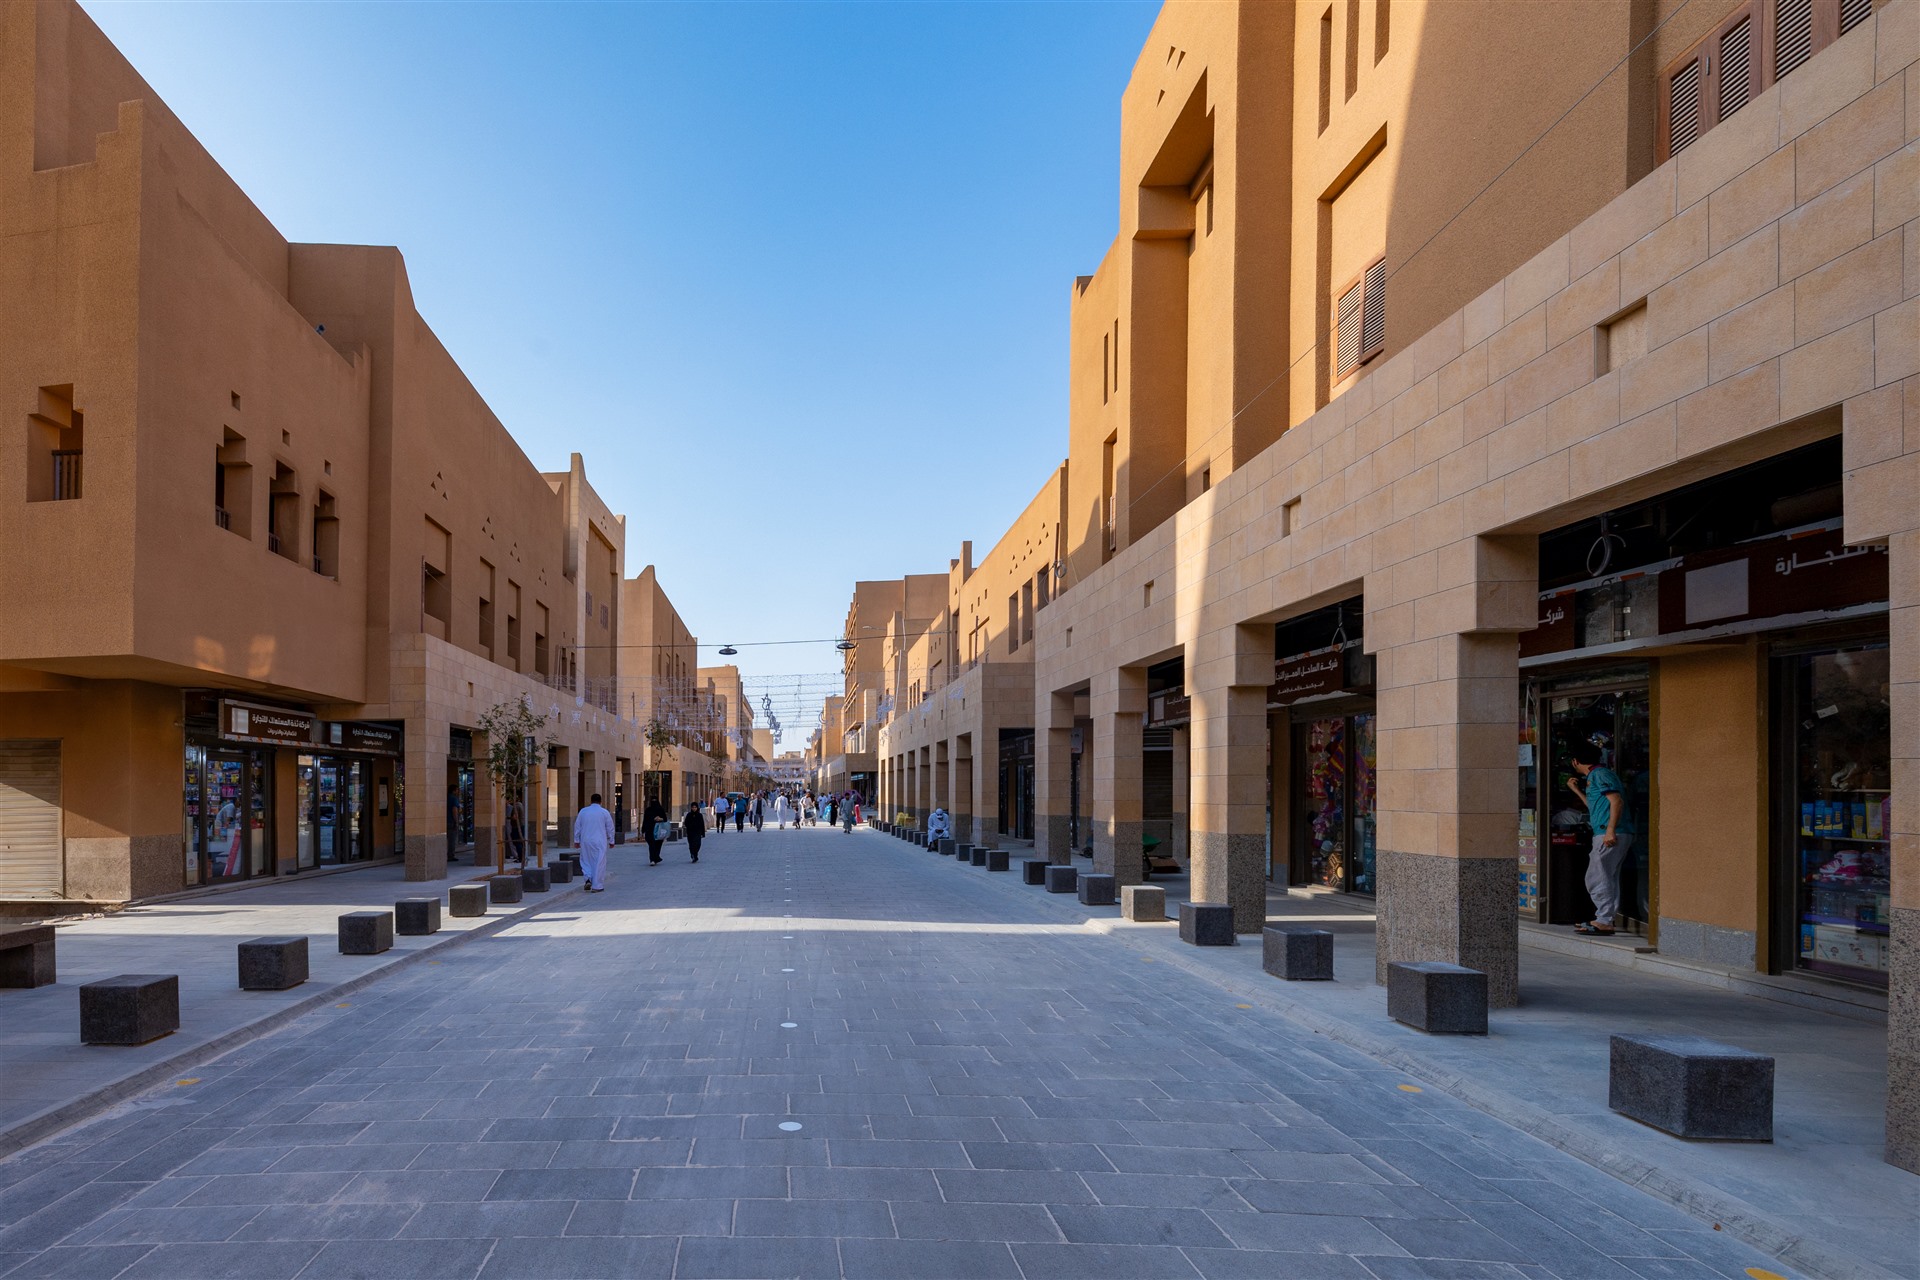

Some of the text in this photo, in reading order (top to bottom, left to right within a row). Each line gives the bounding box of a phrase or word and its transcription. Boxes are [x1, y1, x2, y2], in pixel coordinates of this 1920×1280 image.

[1538, 606, 1565, 625] شرك
[1301, 662, 1320, 677] الساحل
[1320, 658, 1338, 671] شركة
[252, 713, 268, 724] للتجارة
[298, 721, 310, 730] شركة
